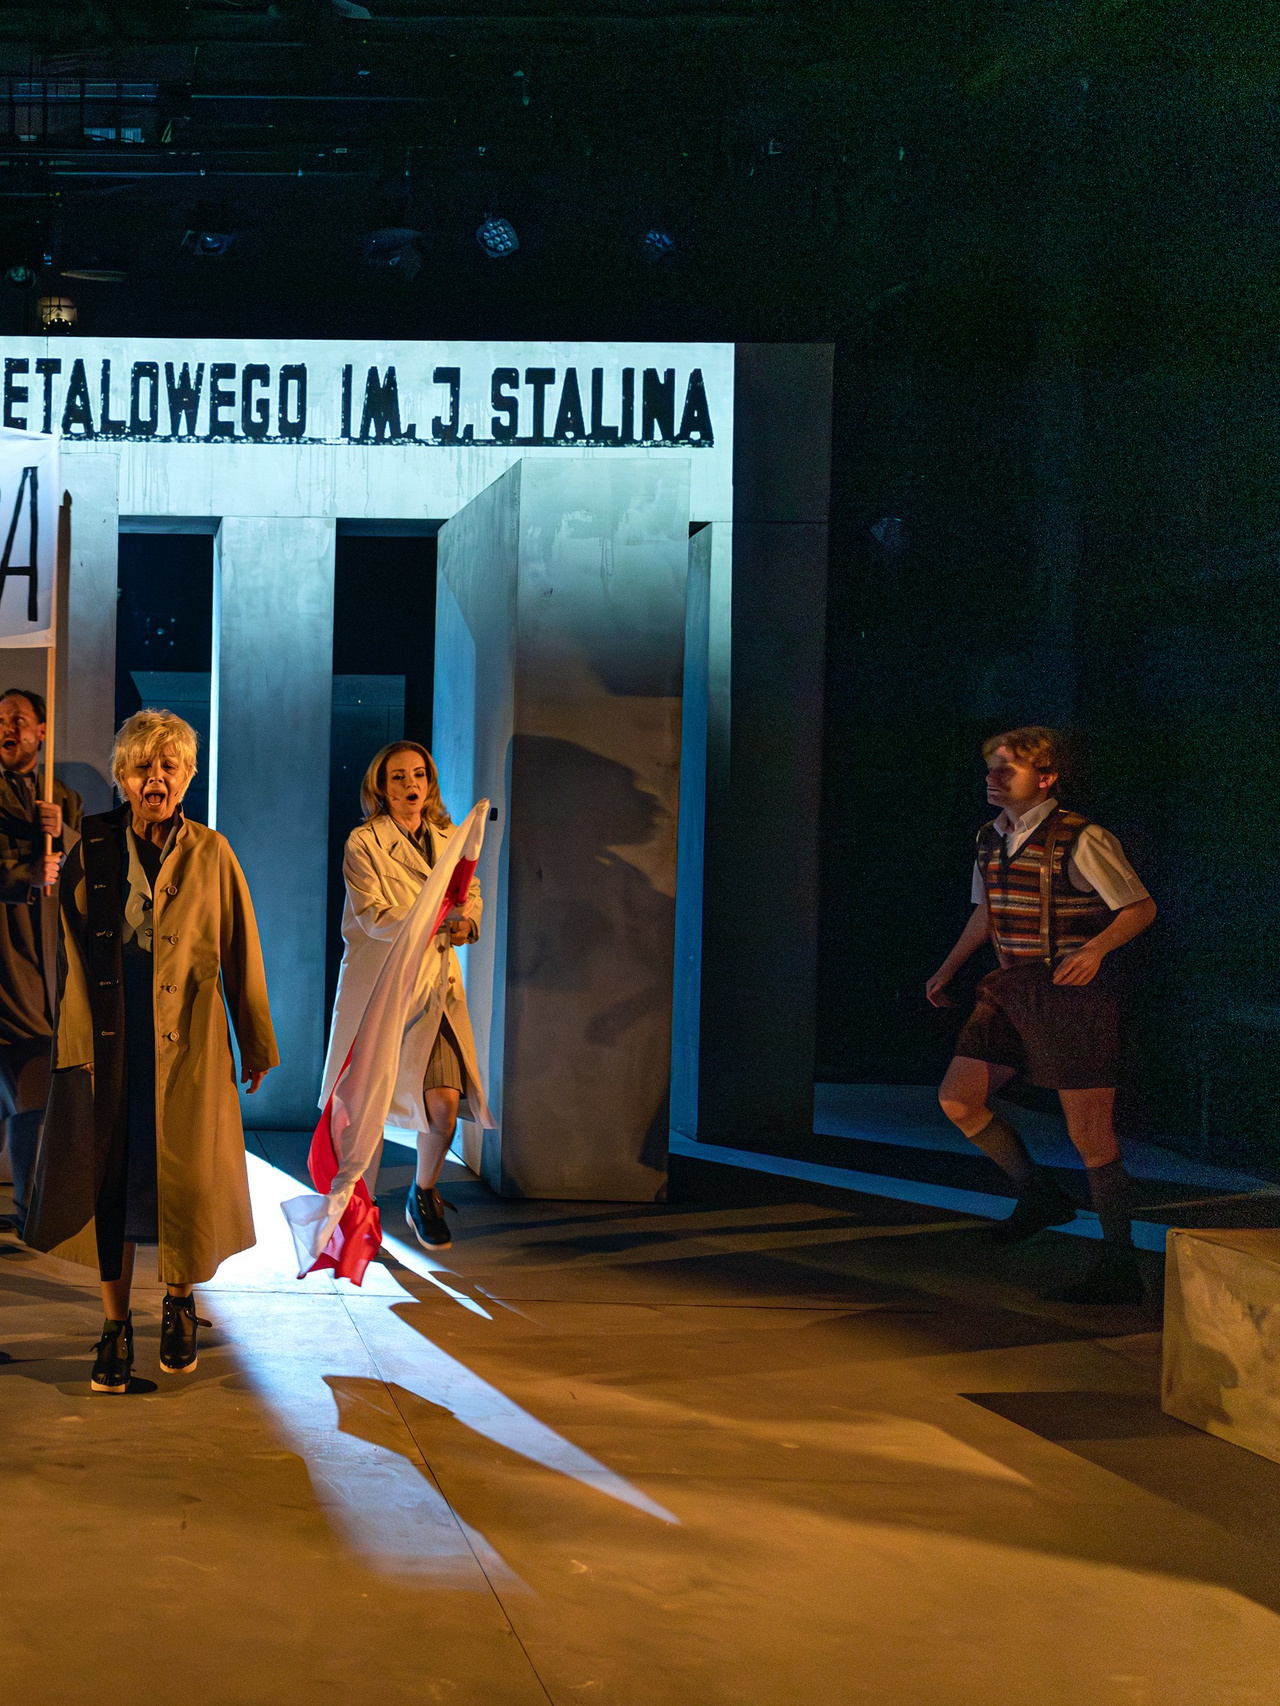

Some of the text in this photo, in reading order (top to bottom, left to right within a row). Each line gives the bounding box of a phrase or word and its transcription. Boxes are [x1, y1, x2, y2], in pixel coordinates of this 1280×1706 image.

[340, 363, 417, 443] IM.
[431, 366, 474, 445] J.
[491, 366, 714, 447] STALINA
